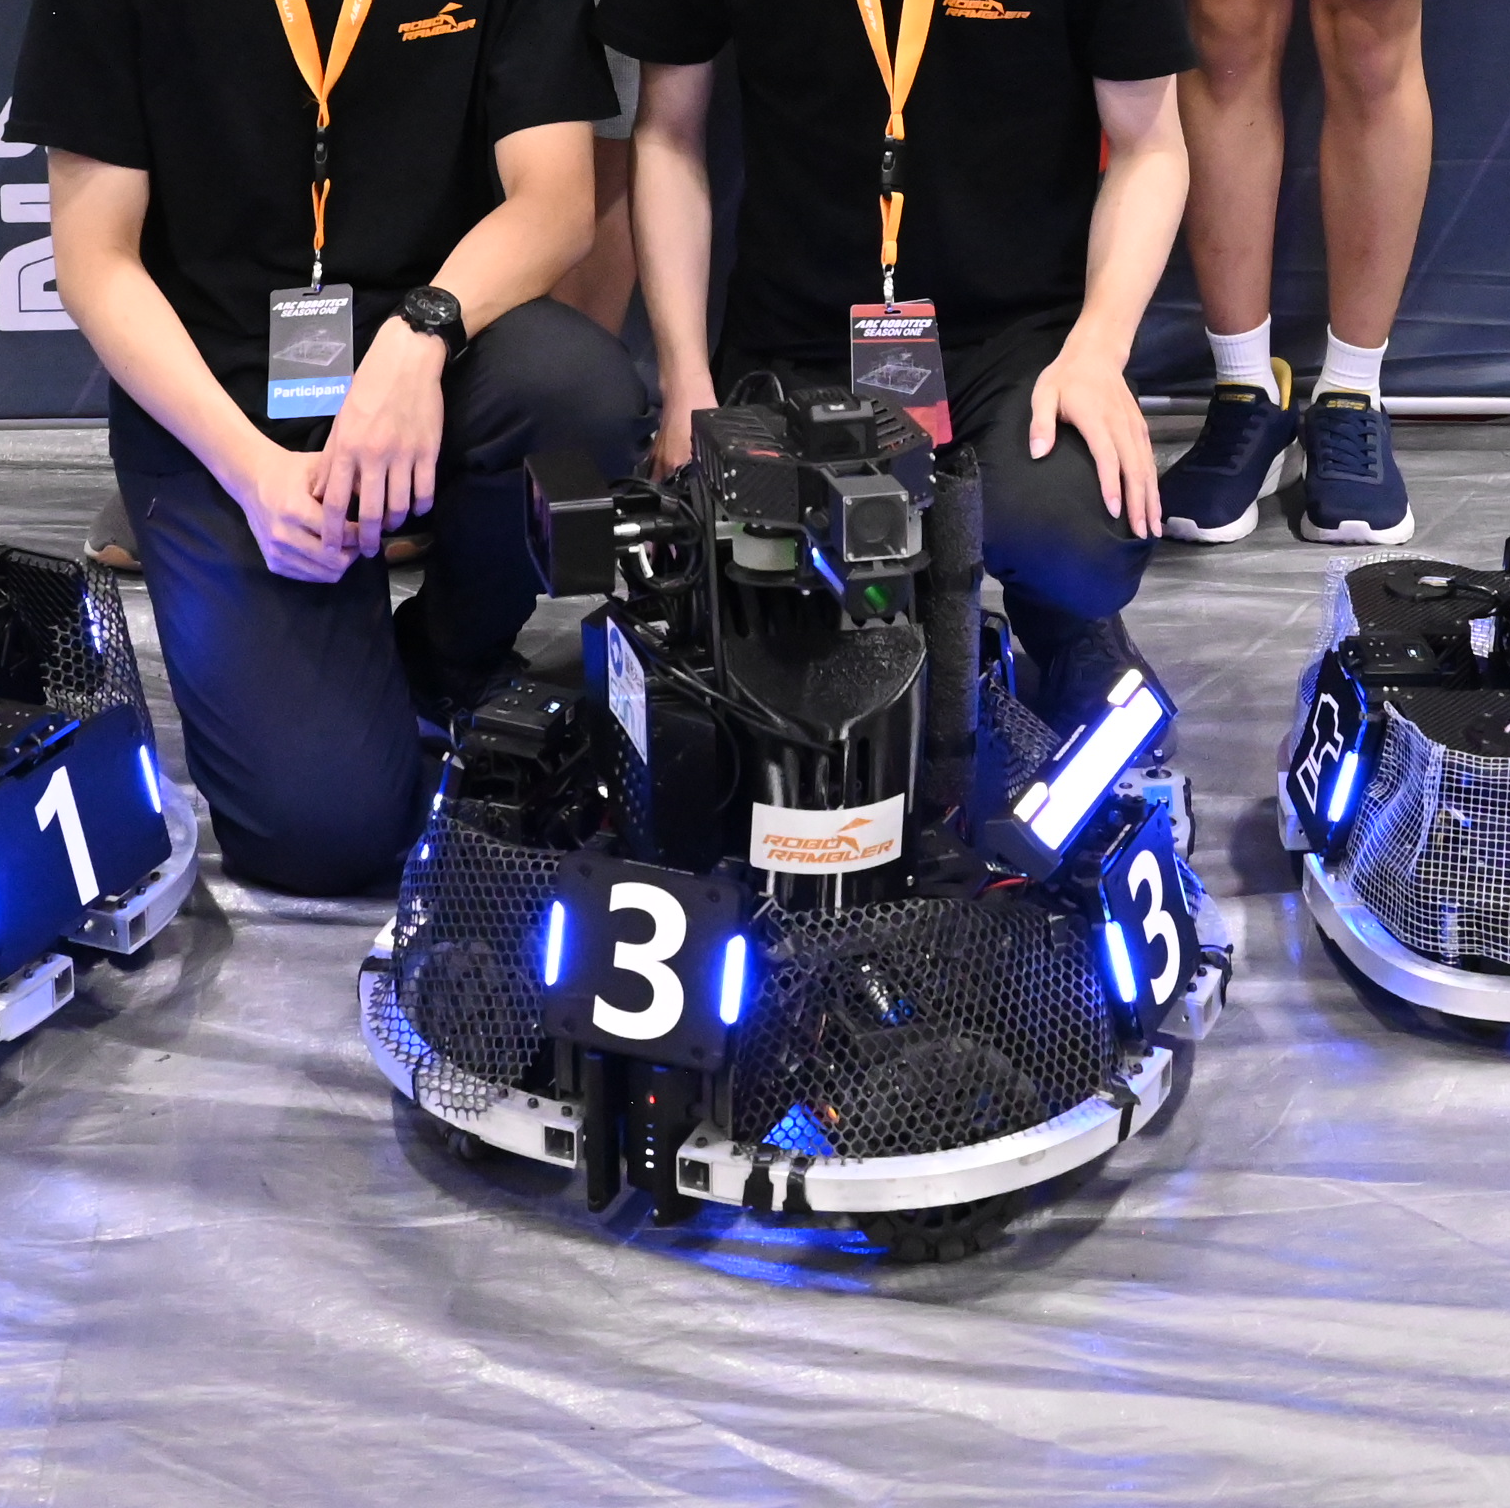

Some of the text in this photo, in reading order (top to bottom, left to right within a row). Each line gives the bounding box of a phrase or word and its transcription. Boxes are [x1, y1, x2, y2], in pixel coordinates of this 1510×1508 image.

[272, 297, 349, 312] ARC ROBOTICS
[280, 306, 339, 318] SEASON ONE
[854, 318, 933, 329] ARC ROBOTICS
[863, 327, 924, 338] SEASON ONE
[273, 383, 346, 399] Participant
[35, 765, 100, 906] 1
[762, 834, 843, 850] ROBO
[766, 838, 895, 864] RAMBLER
[1127, 849, 1181, 1005] 3
[592, 882, 687, 1040] 3
